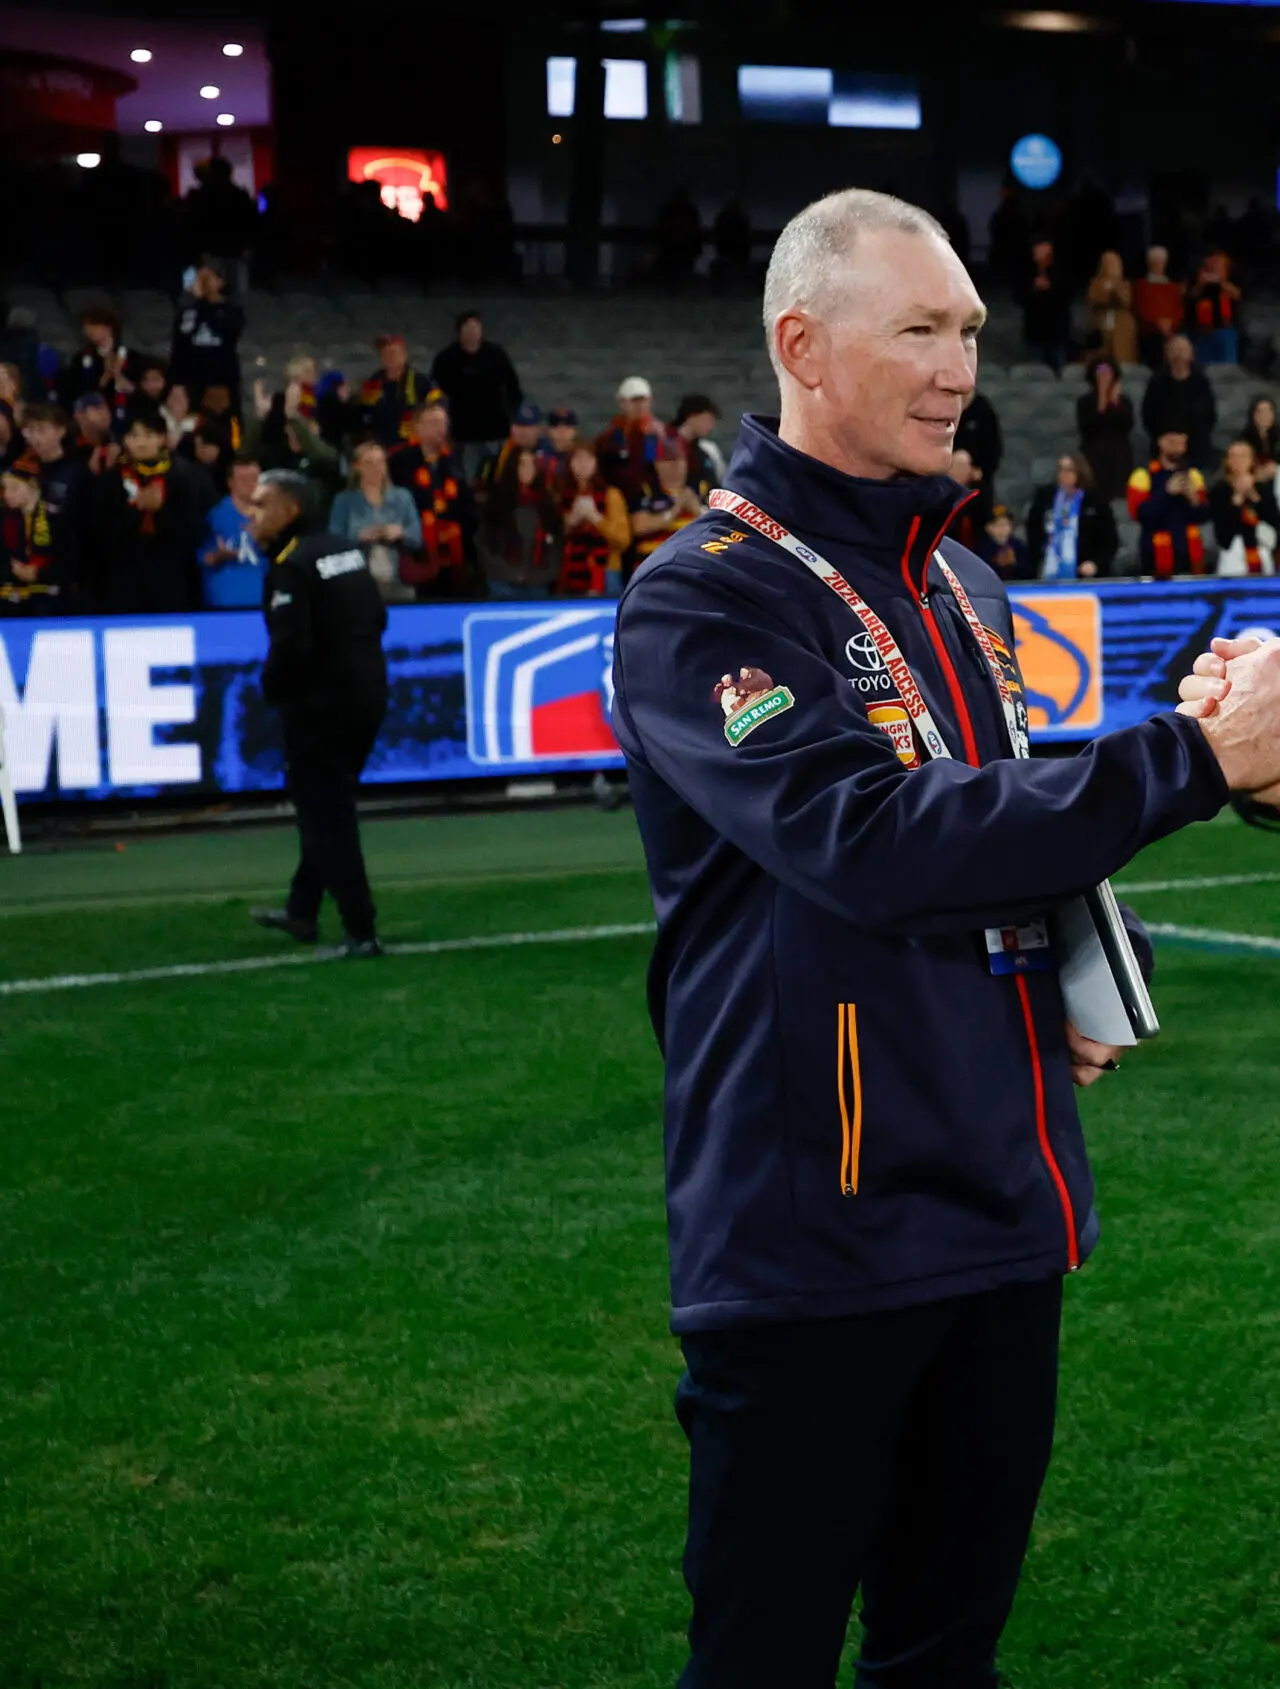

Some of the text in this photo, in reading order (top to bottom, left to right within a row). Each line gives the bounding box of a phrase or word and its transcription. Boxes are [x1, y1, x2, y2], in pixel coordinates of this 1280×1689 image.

[732, 501, 789, 541] ACCESS
[823, 571, 927, 719] 2026 ARENA ACCESS
[848, 674, 897, 692] TOYO
[731, 715, 752, 736] SAN
[751, 696, 782, 720] REMO
